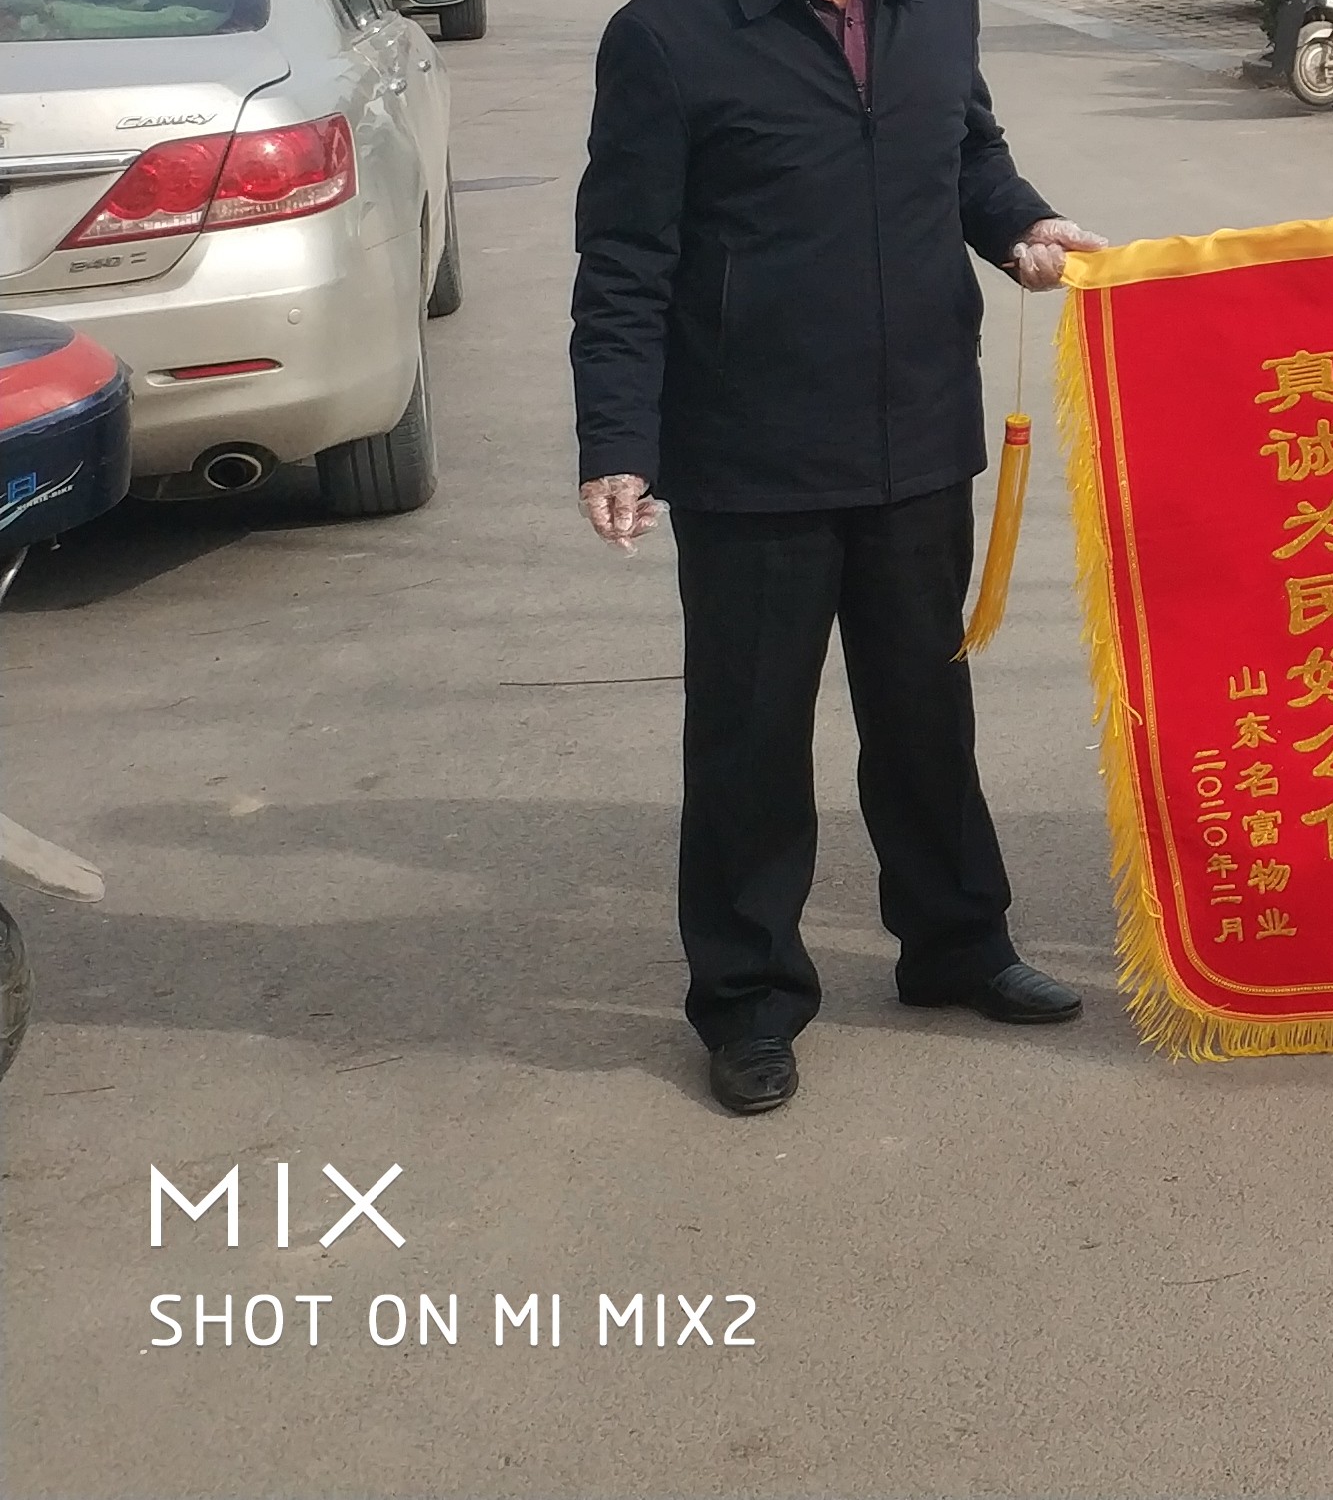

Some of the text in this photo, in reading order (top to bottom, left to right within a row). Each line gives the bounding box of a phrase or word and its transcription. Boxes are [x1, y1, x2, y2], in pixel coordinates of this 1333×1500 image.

[1228, 666, 1297, 940] 山东名富物业
